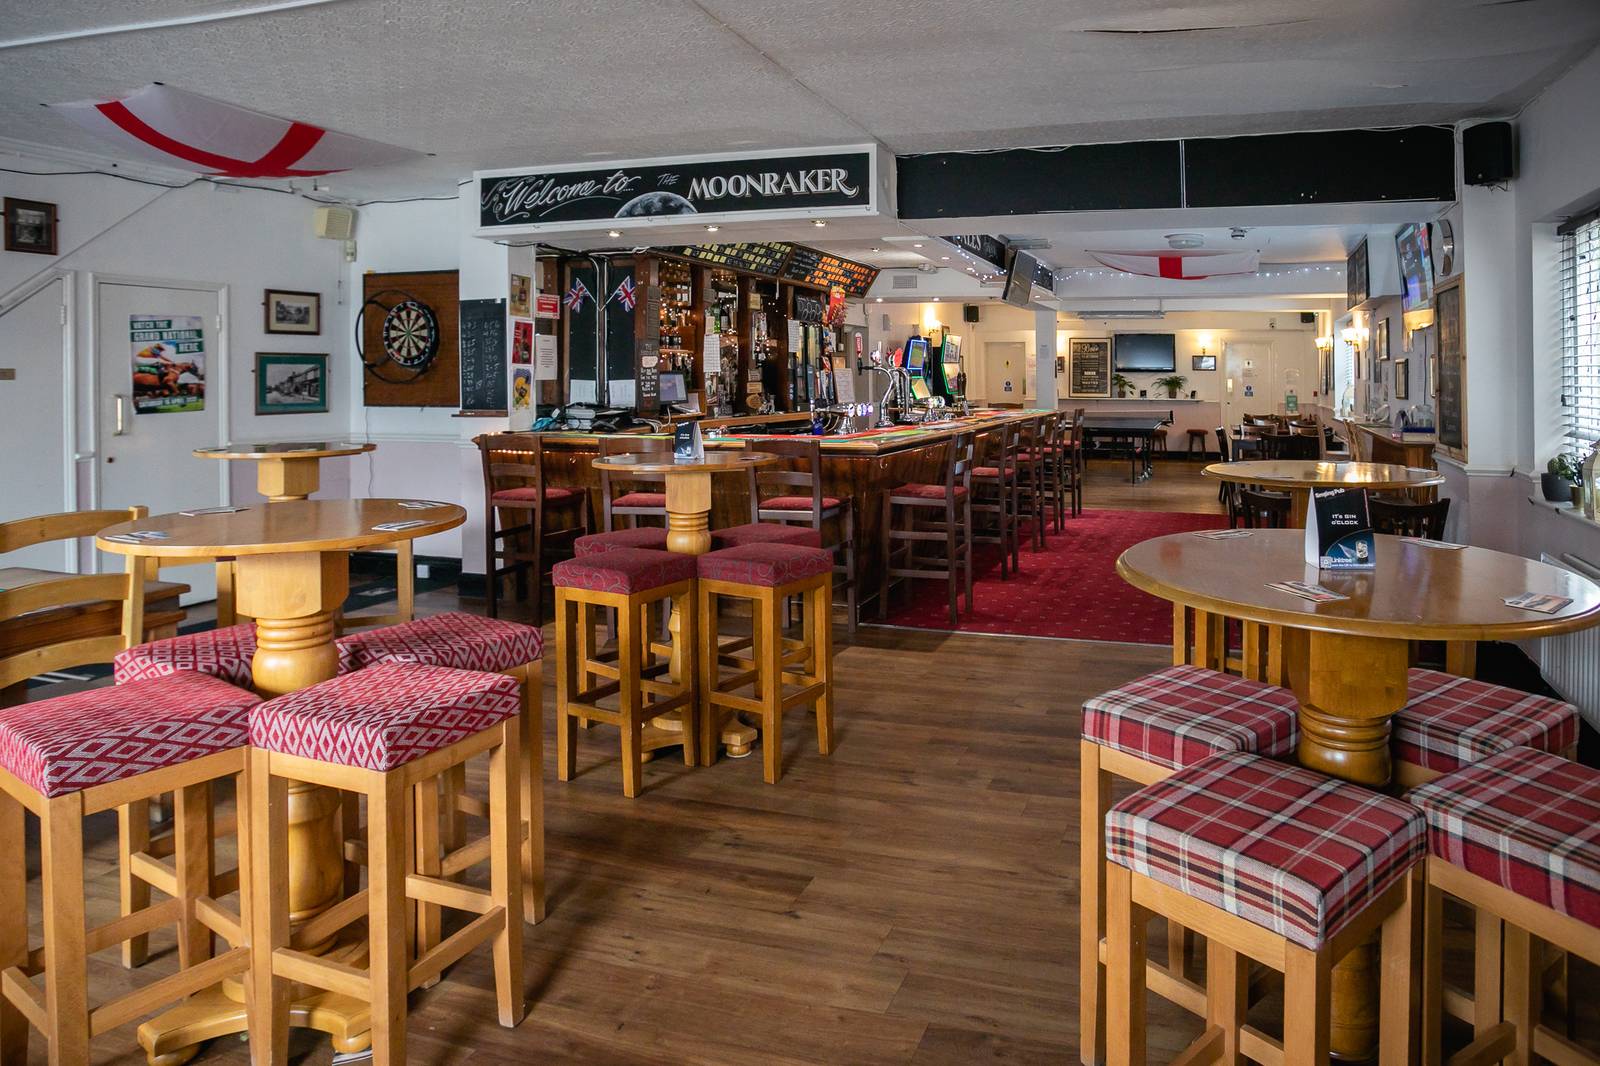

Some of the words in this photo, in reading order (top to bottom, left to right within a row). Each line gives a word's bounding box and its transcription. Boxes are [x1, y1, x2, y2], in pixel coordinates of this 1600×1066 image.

[657, 173, 680, 186] THE
[686, 168, 859, 201] MOONRAKER
[502, 178, 602, 215] Welcome
[134, 332, 160, 341] GRAND
[179, 342, 199, 353] HERE
